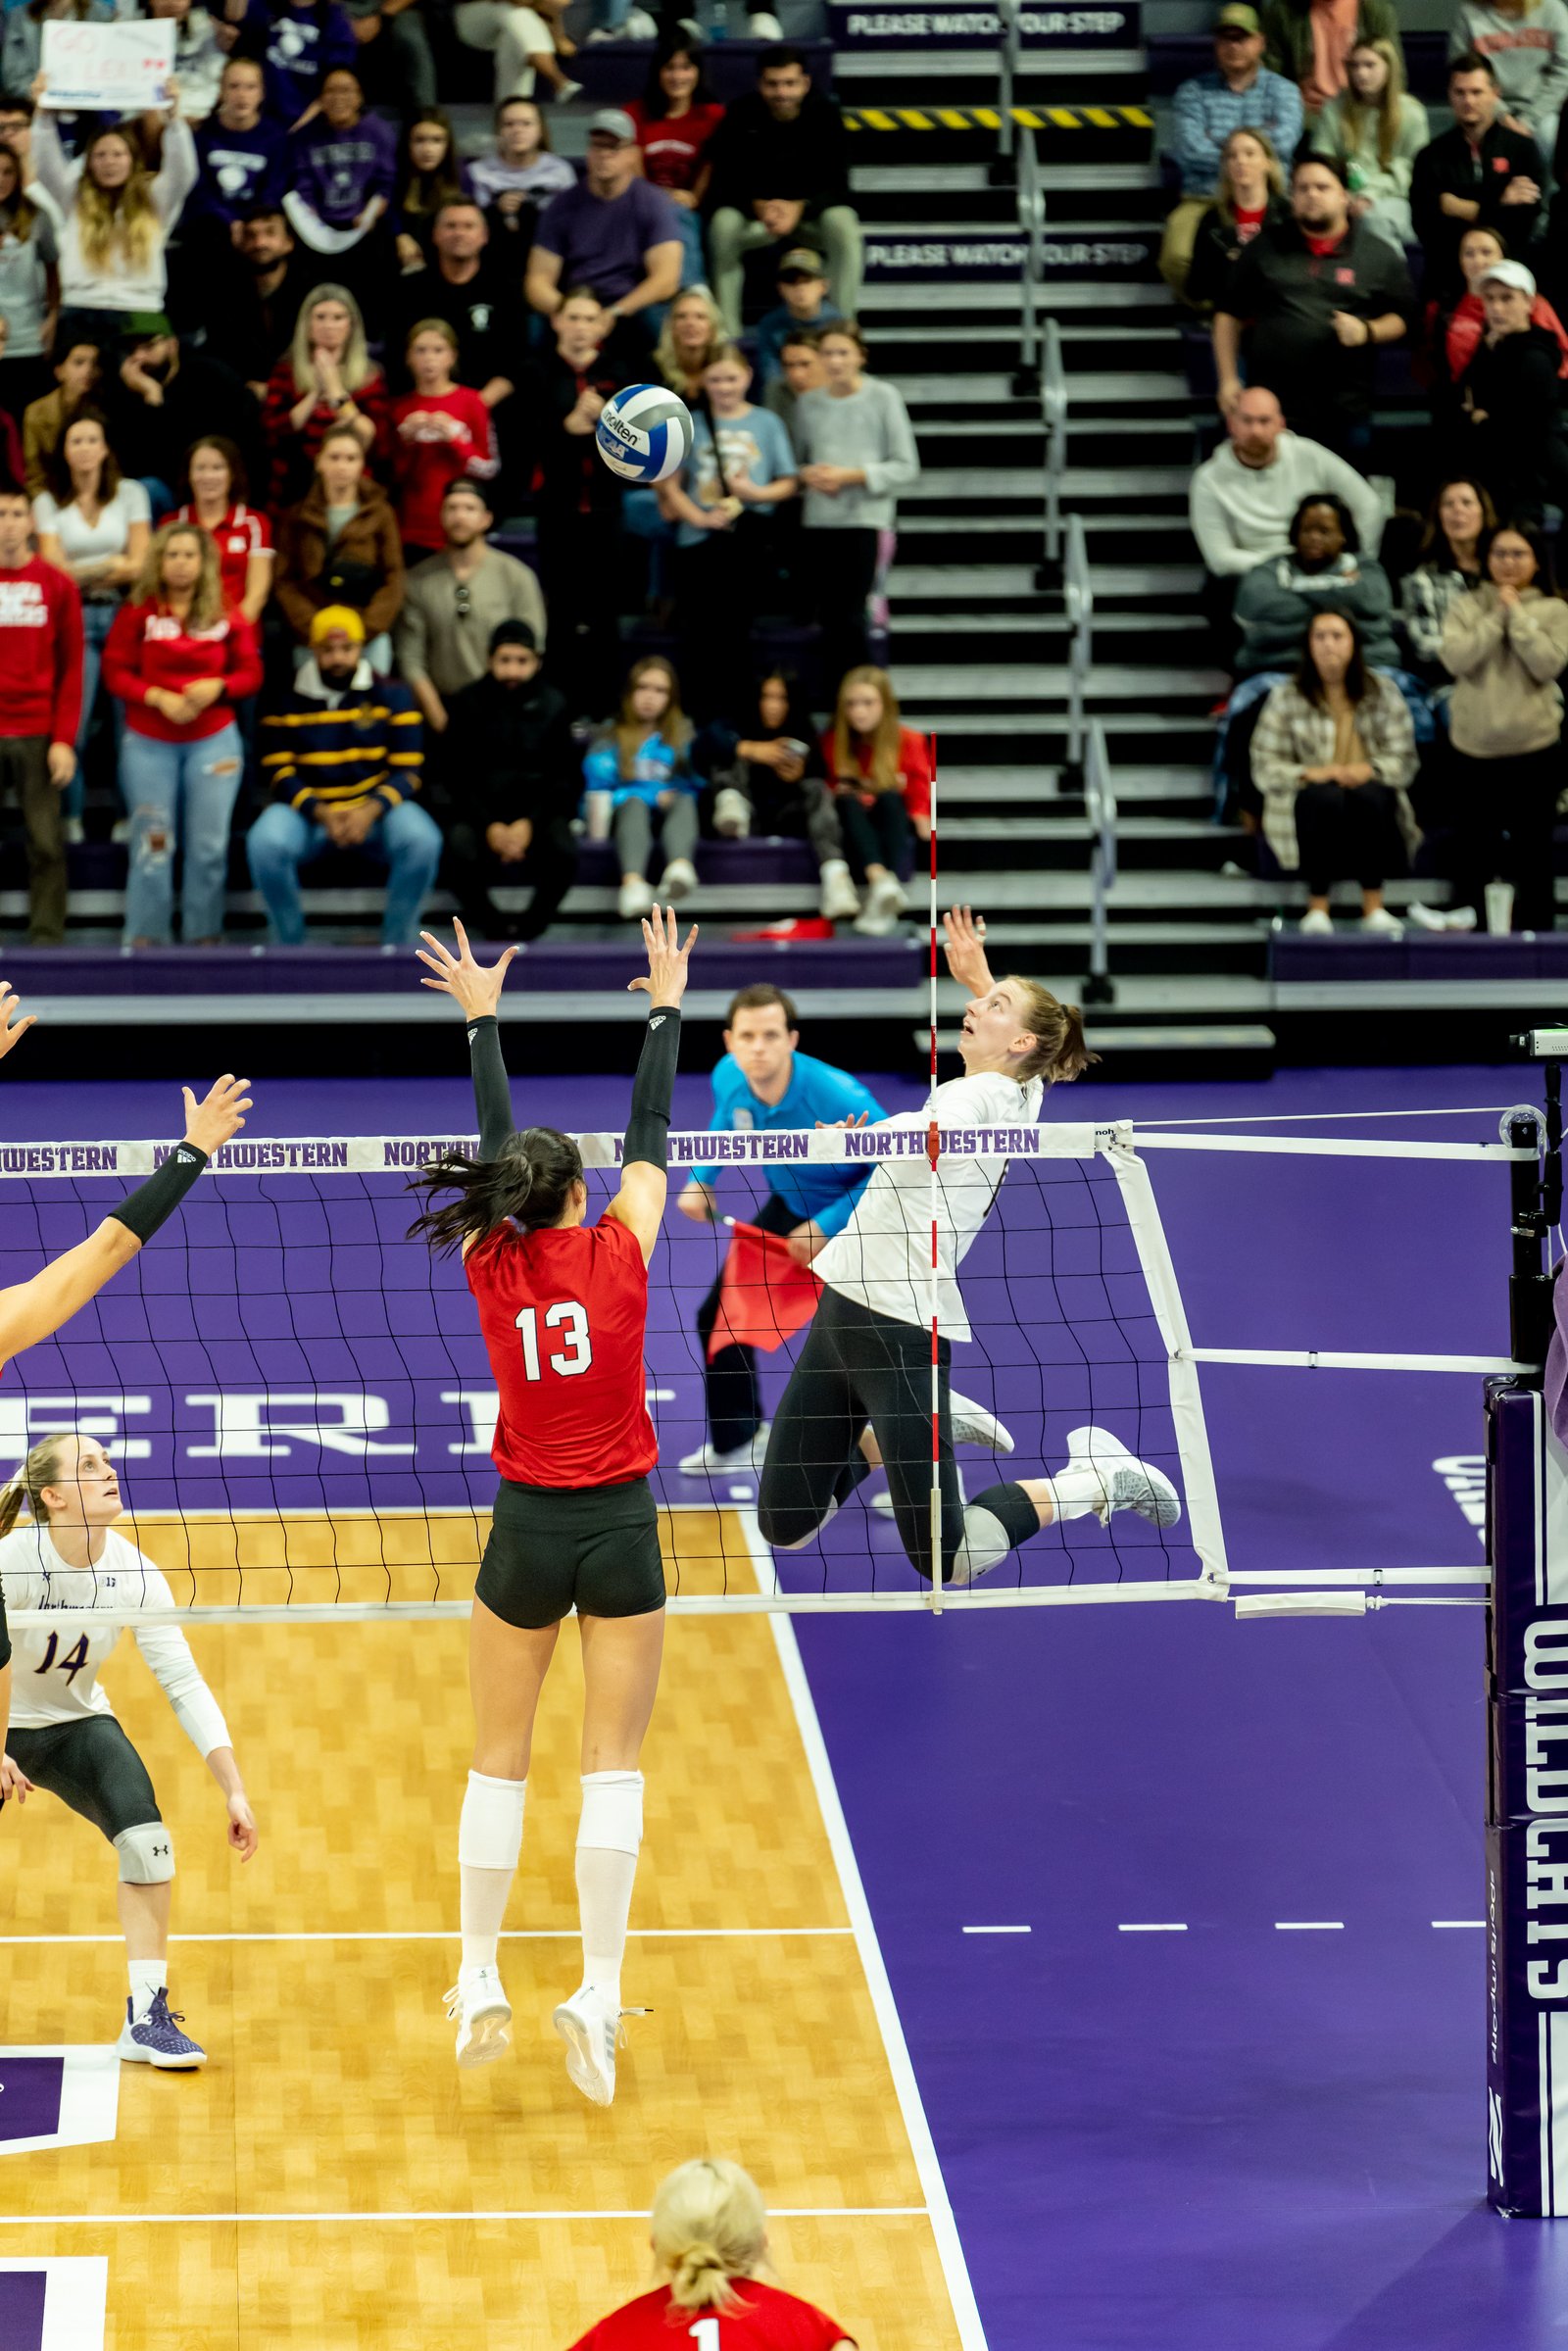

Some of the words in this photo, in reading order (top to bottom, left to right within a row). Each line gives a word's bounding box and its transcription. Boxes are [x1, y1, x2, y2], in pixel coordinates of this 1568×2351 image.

[847, 14, 931, 35] PLEASE
[933, 13, 1007, 34] WATC
[1015, 12, 1067, 33] OUR
[1069, 11, 1126, 33] STEP
[866, 244, 949, 267] PLEASE
[1041, 242, 1089, 266] OUR
[1091, 242, 1149, 265] STEP
[0, 1146, 118, 1172] WESTERN
[153, 1142, 348, 1169] NHWESTERN
[613, 1134, 809, 1162] NTHWESTERN
[514, 1300, 593, 1383] 13
[33, 1630, 89, 1687] 14
